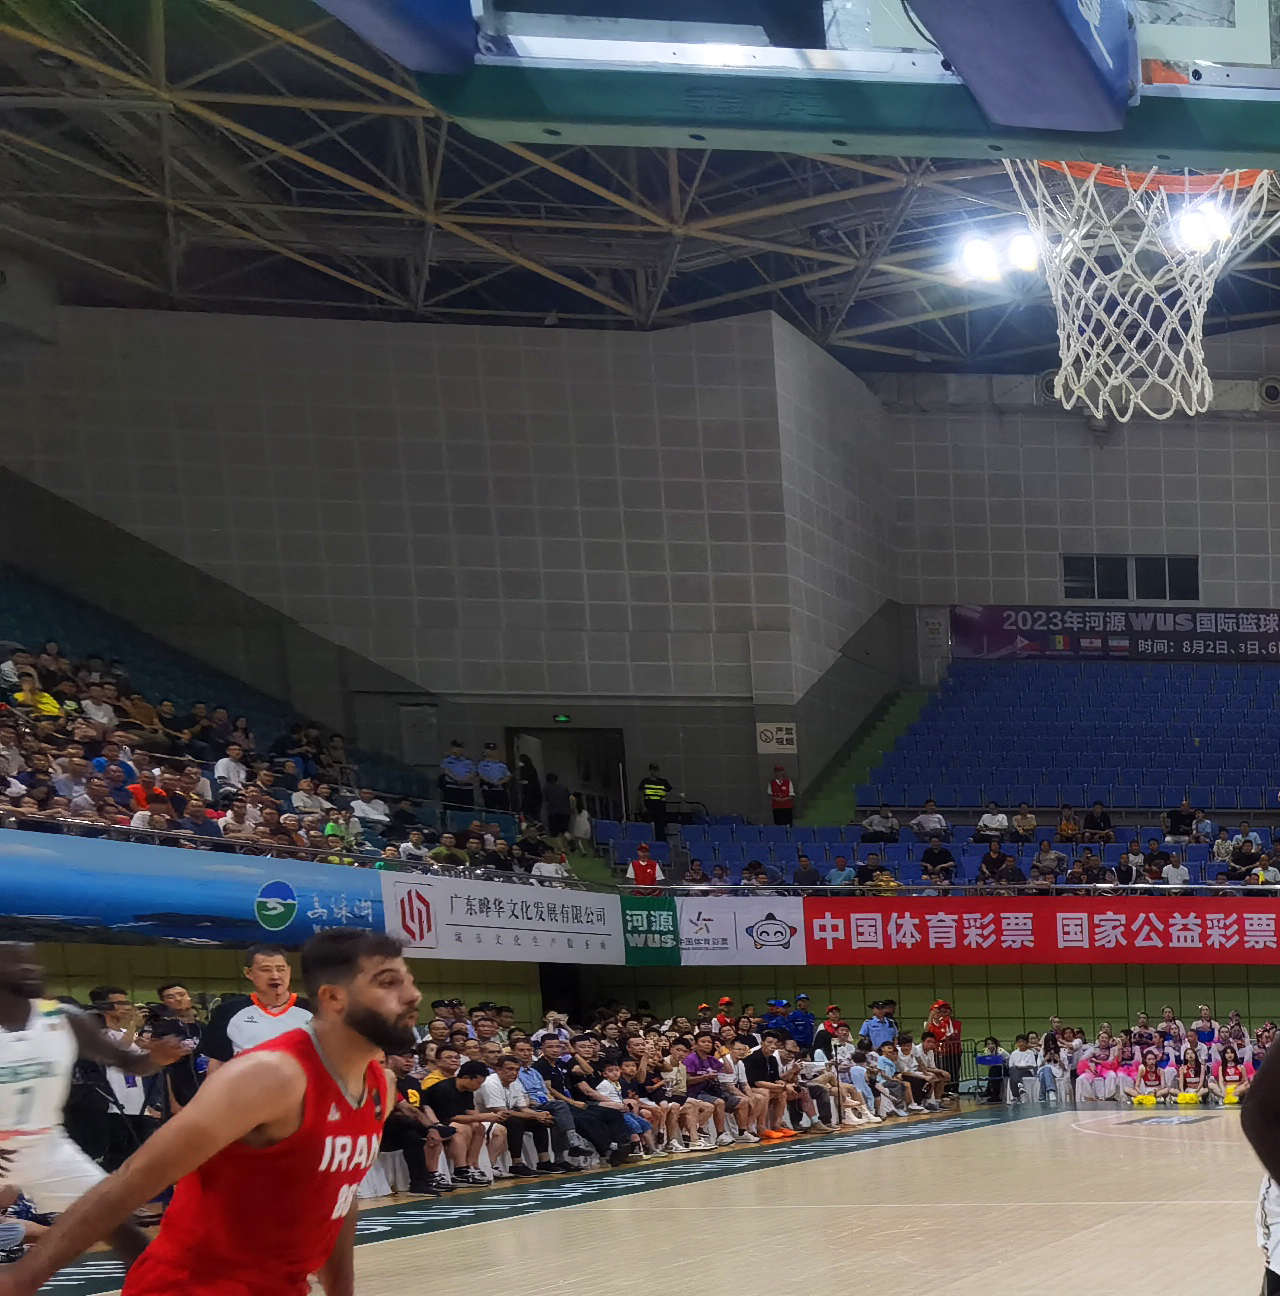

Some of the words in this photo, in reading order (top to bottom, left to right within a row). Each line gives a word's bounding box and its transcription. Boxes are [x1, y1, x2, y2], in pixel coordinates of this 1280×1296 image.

[626, 910, 674, 931] 河源
[813, 911, 1035, 950] 中国体育彩票
[1057, 910, 1279, 950] 国家公益彩票
[626, 933, 676, 948] WUS
[318, 1132, 380, 1173] IRAN
